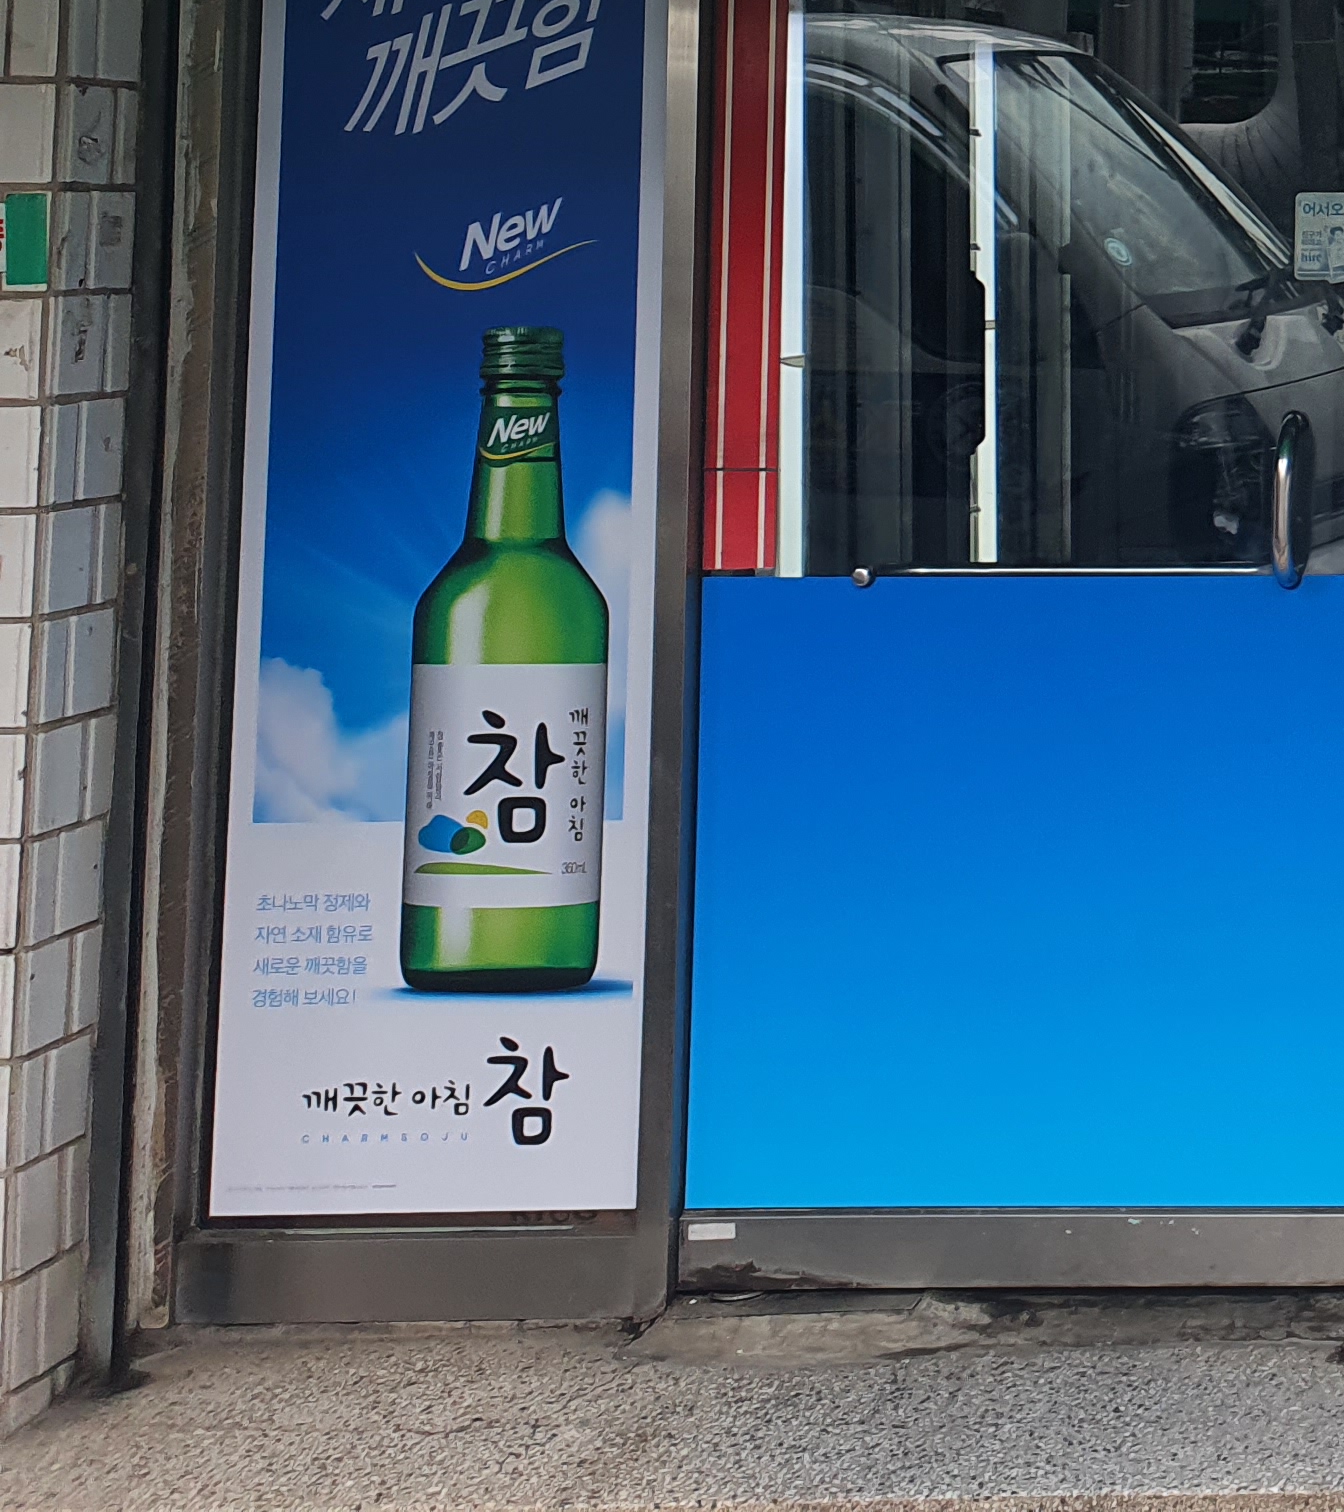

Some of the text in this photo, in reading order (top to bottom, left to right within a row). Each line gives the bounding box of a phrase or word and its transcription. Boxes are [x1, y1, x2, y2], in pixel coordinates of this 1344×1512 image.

[459, 196, 563, 272] New
[485, 239, 546, 275] CHARM
[486, 412, 551, 448] New
[463, 710, 565, 843] 참
[568, 707, 589, 842] 깨끗한 아침
[256, 893, 371, 912] 초나노막 정제와
[255, 924, 373, 944] 자연 소재 함유로
[253, 956, 368, 975] 새로운 깨끗함을
[252, 988, 356, 1007] 경험해 보세요!
[301, 1037, 570, 1145] 깨끗한 아침 참
